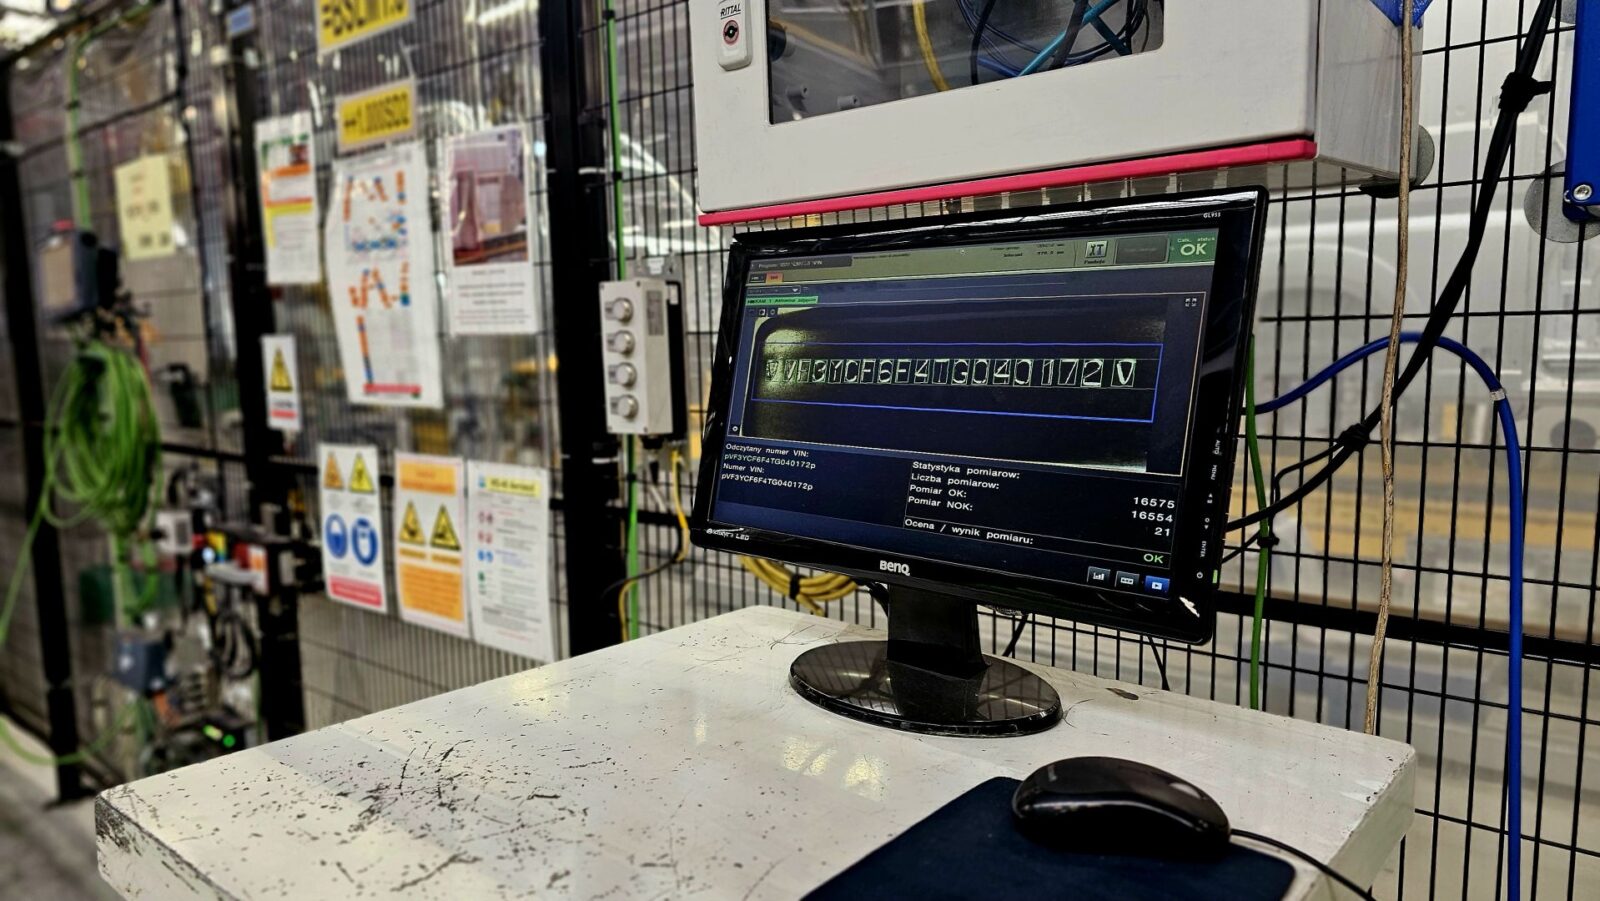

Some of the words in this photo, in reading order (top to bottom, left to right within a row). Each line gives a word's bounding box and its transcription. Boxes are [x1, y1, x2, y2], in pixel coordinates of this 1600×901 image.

[720, 4, 741, 17] RITTAL
[1180, 242, 1207, 256] OK
[726, 443, 762, 453] Odczytany
[766, 448, 789, 456] numer
[793, 449, 809, 458] VIN:
[1213, 440, 1221, 455] AUTO
[723, 463, 746, 471] Numer
[750, 466, 765, 474] VIN:
[912, 461, 960, 473] Statystyka
[966, 467, 1020, 479] pomiarow:
[911, 473, 942, 483] Liczba
[947, 477, 1000, 490] pomiarow:
[909, 484, 943, 495] Pomiar
[948, 488, 967, 498] OK:
[908, 495, 941, 507] Pomiar
[946, 500, 973, 511] NOK:
[1133, 497, 1175, 509] 16575
[1131, 510, 1173, 523] 16554
[904, 518, 935, 530] Ocena
[940, 524, 947, 533] /
[951, 525, 980, 537] wynik
[986, 531, 1034, 544] pomiaru:
[1154, 527, 1170, 537] 21
[1143, 553, 1164, 564] OK
[880, 560, 910, 576] BenQ
